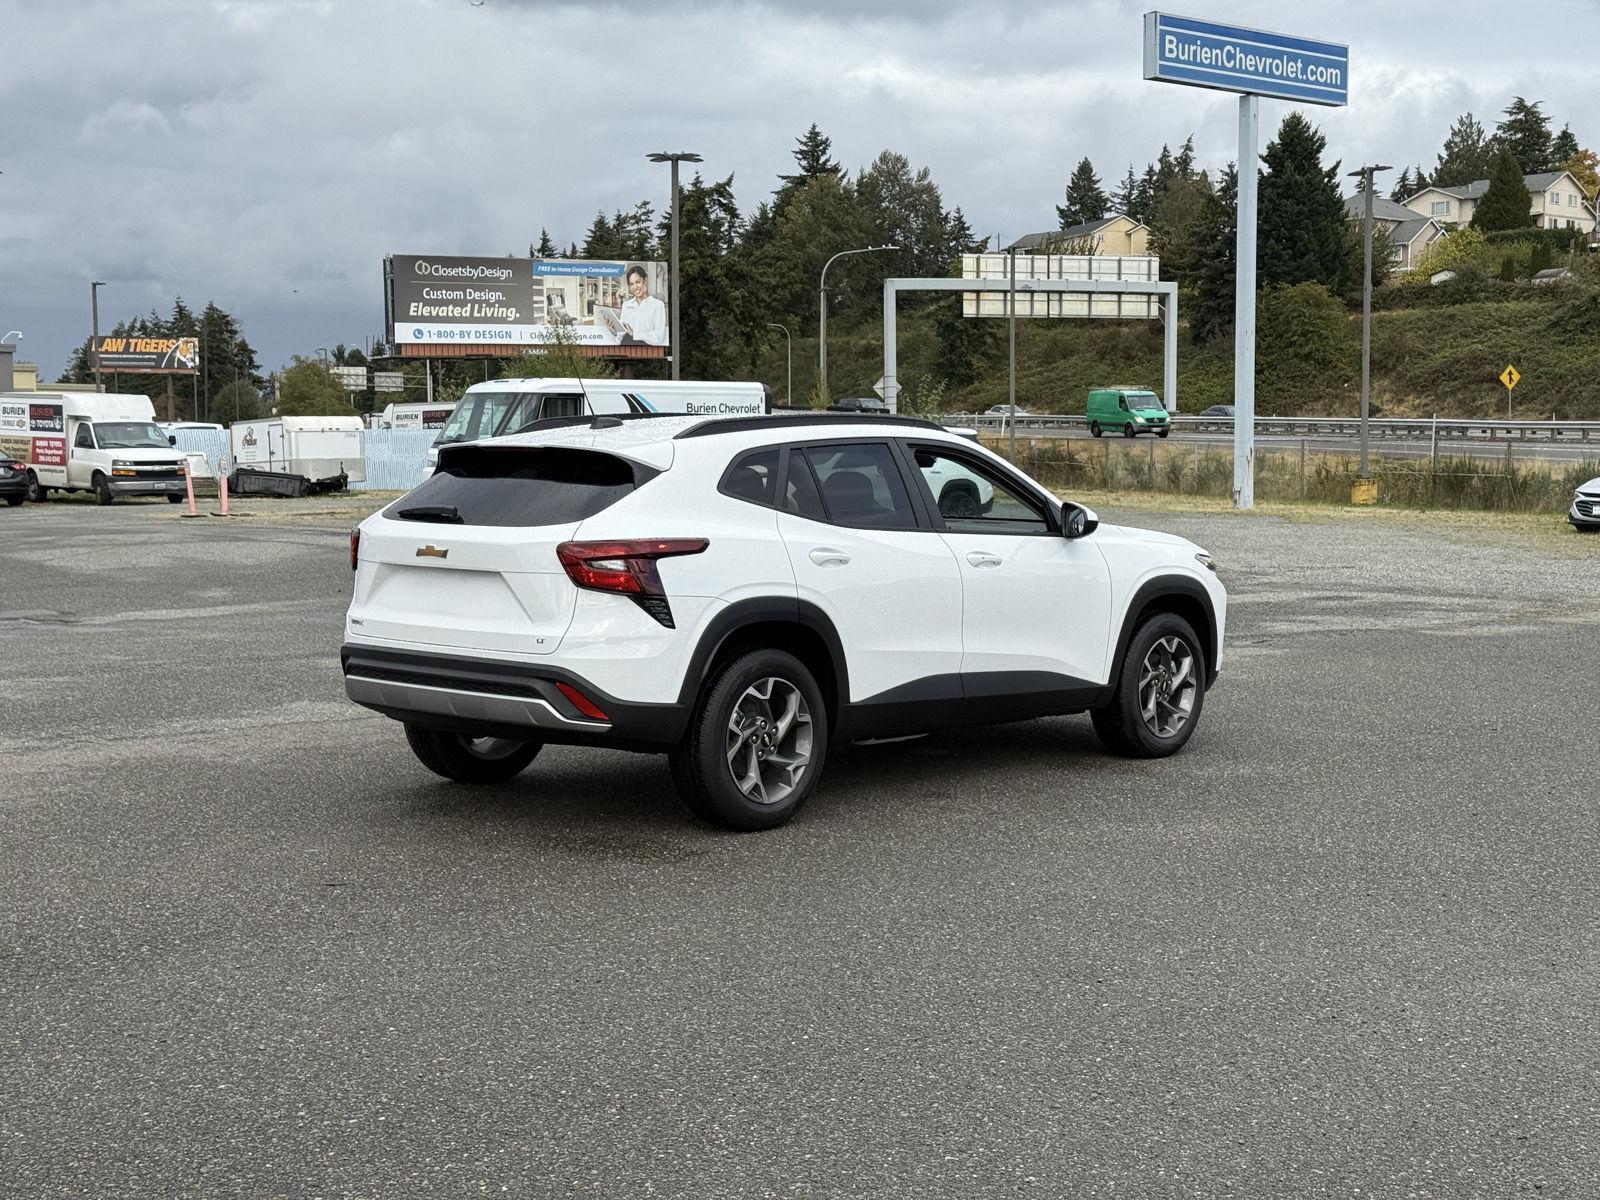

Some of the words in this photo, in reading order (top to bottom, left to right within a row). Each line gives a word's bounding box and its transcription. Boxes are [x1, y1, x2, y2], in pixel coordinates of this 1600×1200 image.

[1164, 34, 1341, 86] BurienChevrolet.com
[431, 264, 513, 280] ClosetsbyDesign
[537, 265, 551, 273] FREE
[571, 266, 588, 274] Design
[422, 287, 464, 300] Custom
[466, 288, 506, 303] Design.
[408, 301, 472, 317] Elevated
[473, 303, 521, 321] Living.
[426, 329, 472, 340] 1-800-BY
[474, 330, 513, 340] DESIGN
[128, 338, 177, 353] TIGERS
[2, 406, 26, 416] BURIEN
[30, 407, 54, 417] BURIEN
[686, 402, 717, 414] Burien
[718, 402, 761, 414] Chevrolet
[396, 413, 419, 421] BURIEN
[36, 419, 54, 429] TOYOTA
